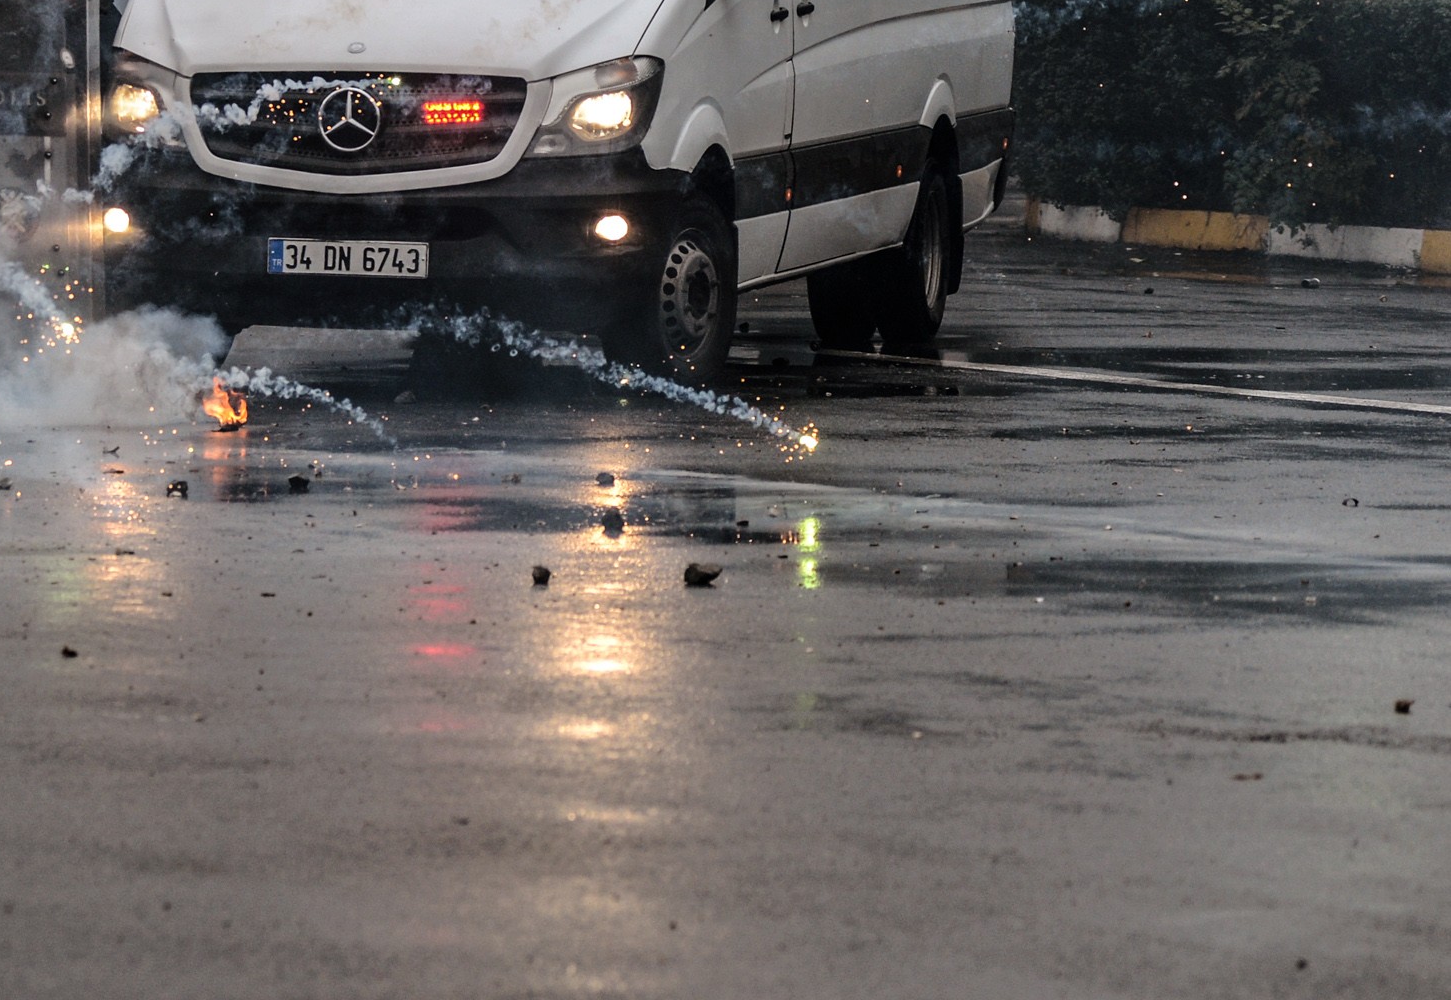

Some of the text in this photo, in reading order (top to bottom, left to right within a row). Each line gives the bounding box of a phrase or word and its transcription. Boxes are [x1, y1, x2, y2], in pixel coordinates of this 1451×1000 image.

[272, 244, 421, 274] TR 34 DN 6743
